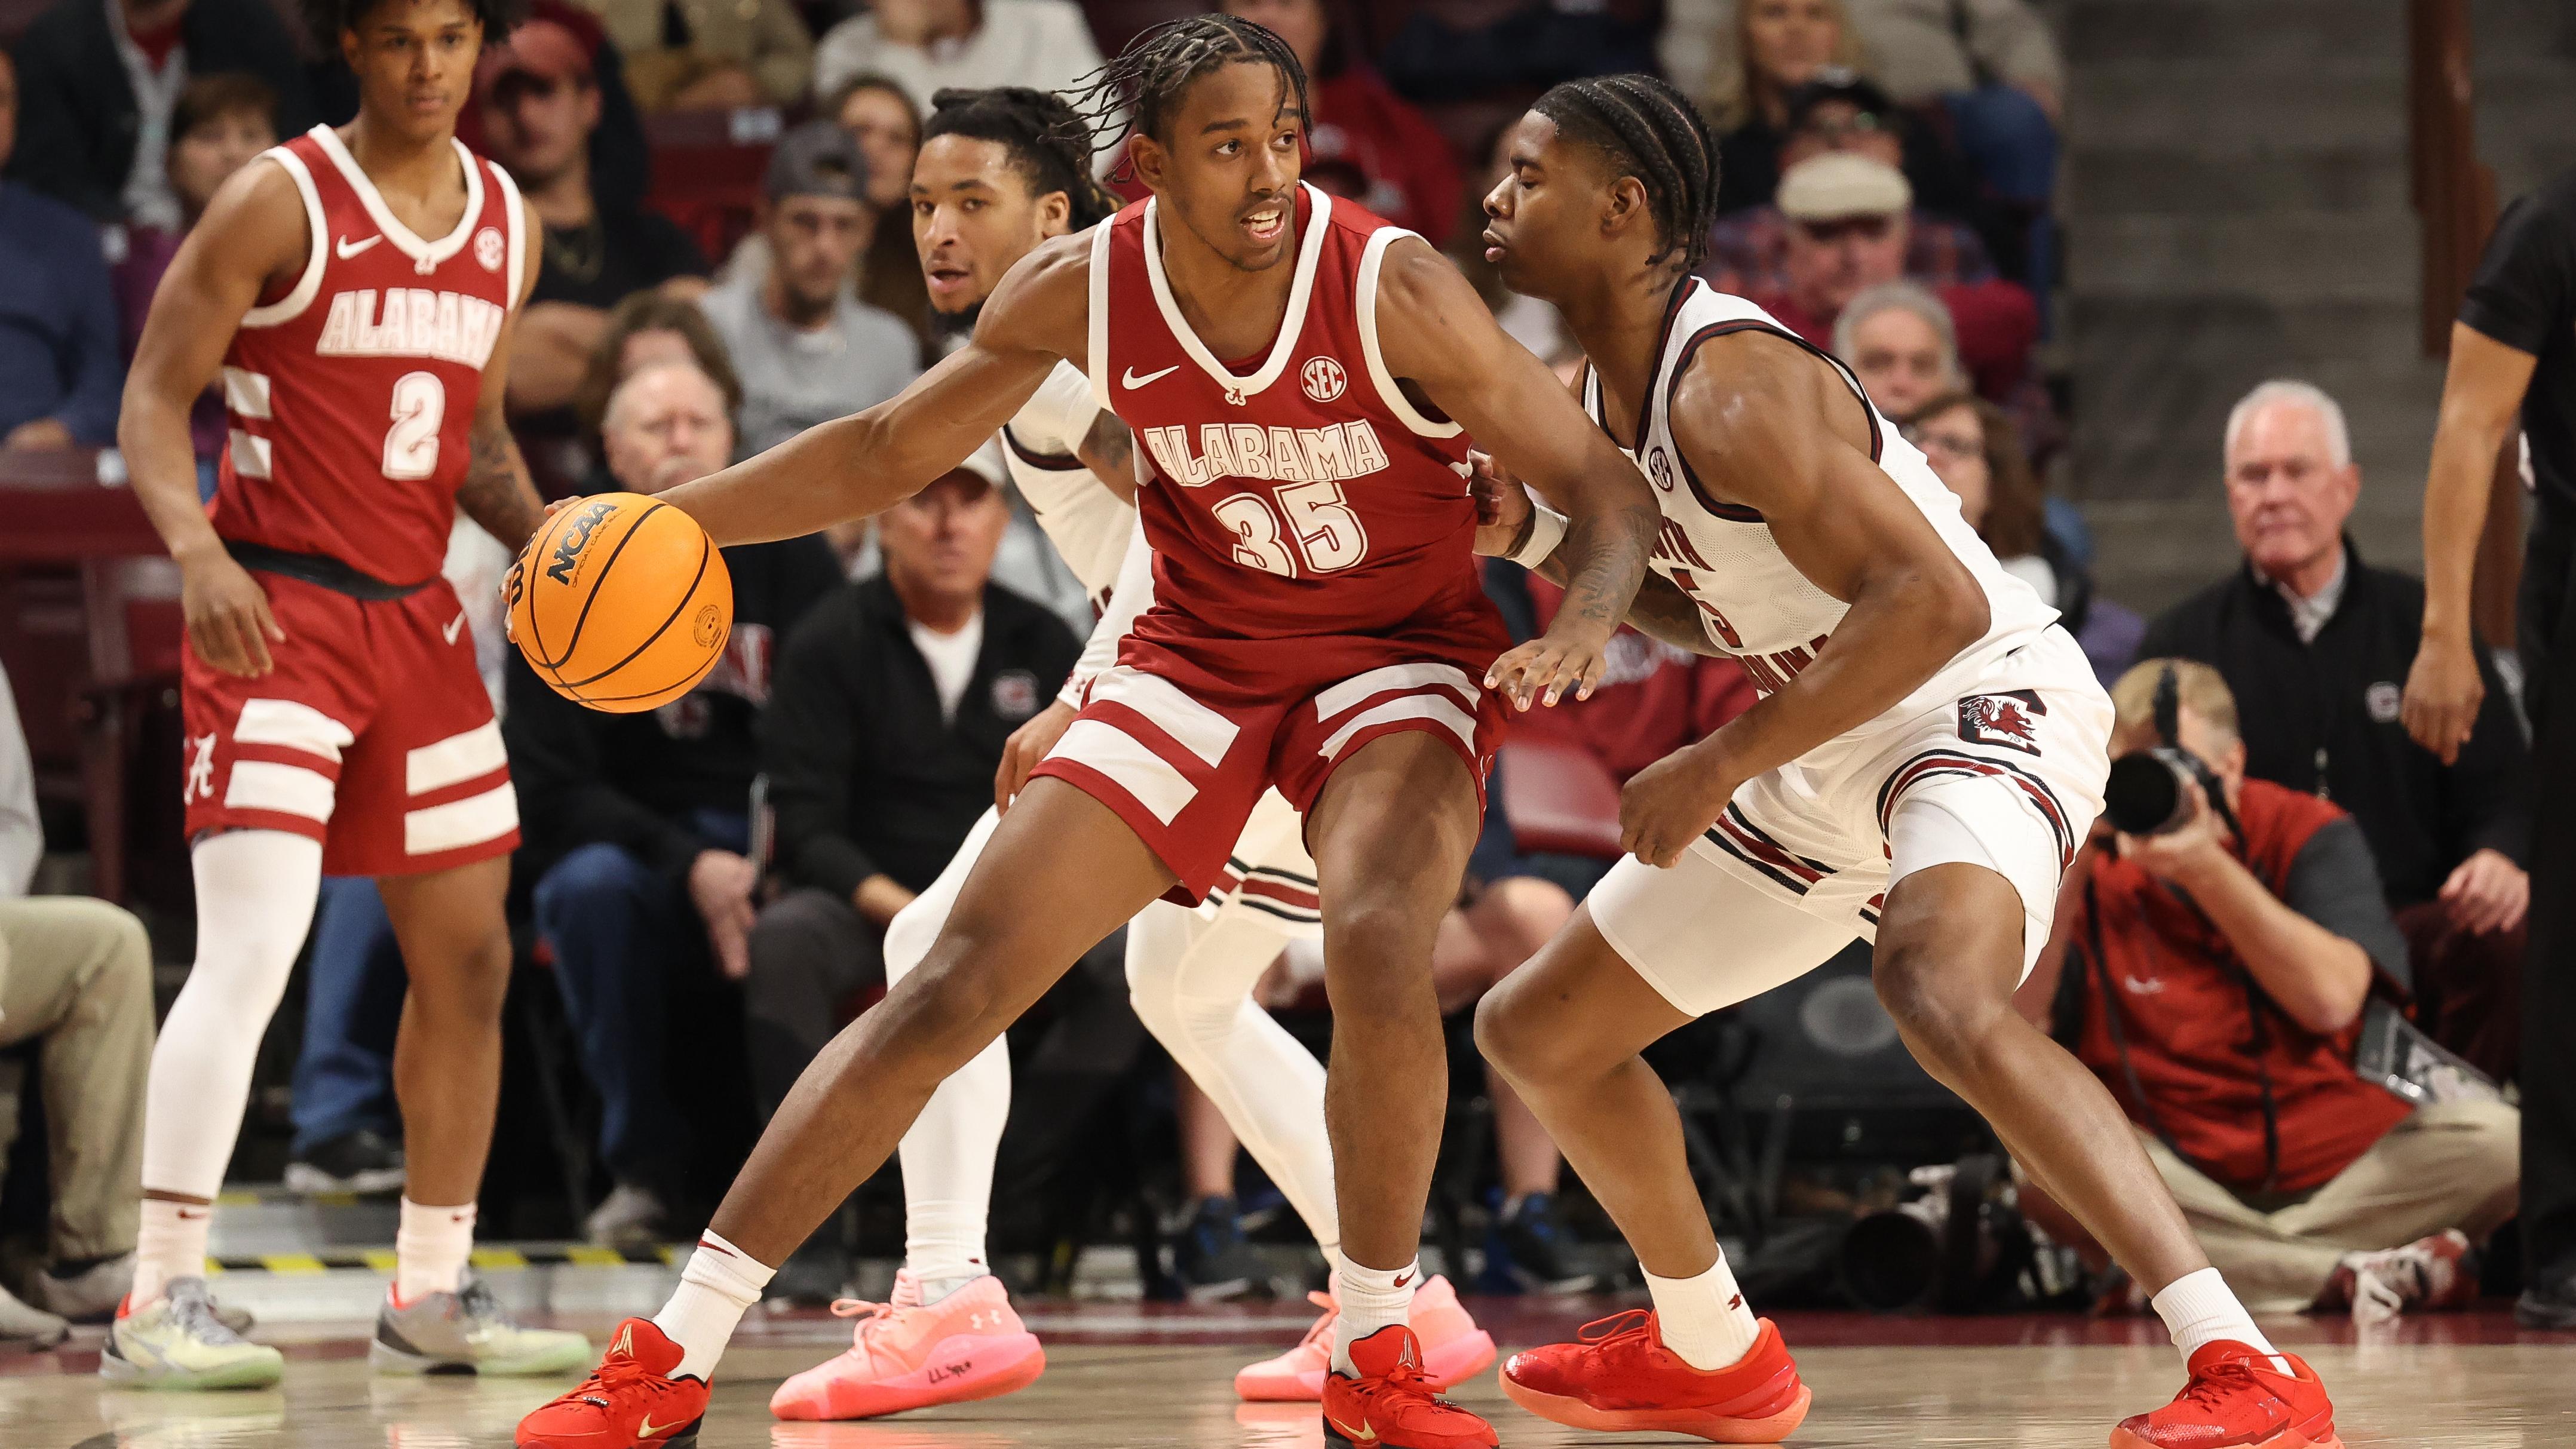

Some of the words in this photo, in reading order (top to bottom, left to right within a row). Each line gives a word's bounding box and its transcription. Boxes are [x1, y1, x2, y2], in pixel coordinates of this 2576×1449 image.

[1304, 360, 1343, 399] SEC
[382, 371, 446, 481] 2
[1143, 418, 1390, 487] ALABAMA
[1650, 450, 1671, 489] SEC
[547, 504, 618, 585] NCAA
[1211, 482, 1369, 579] 35
